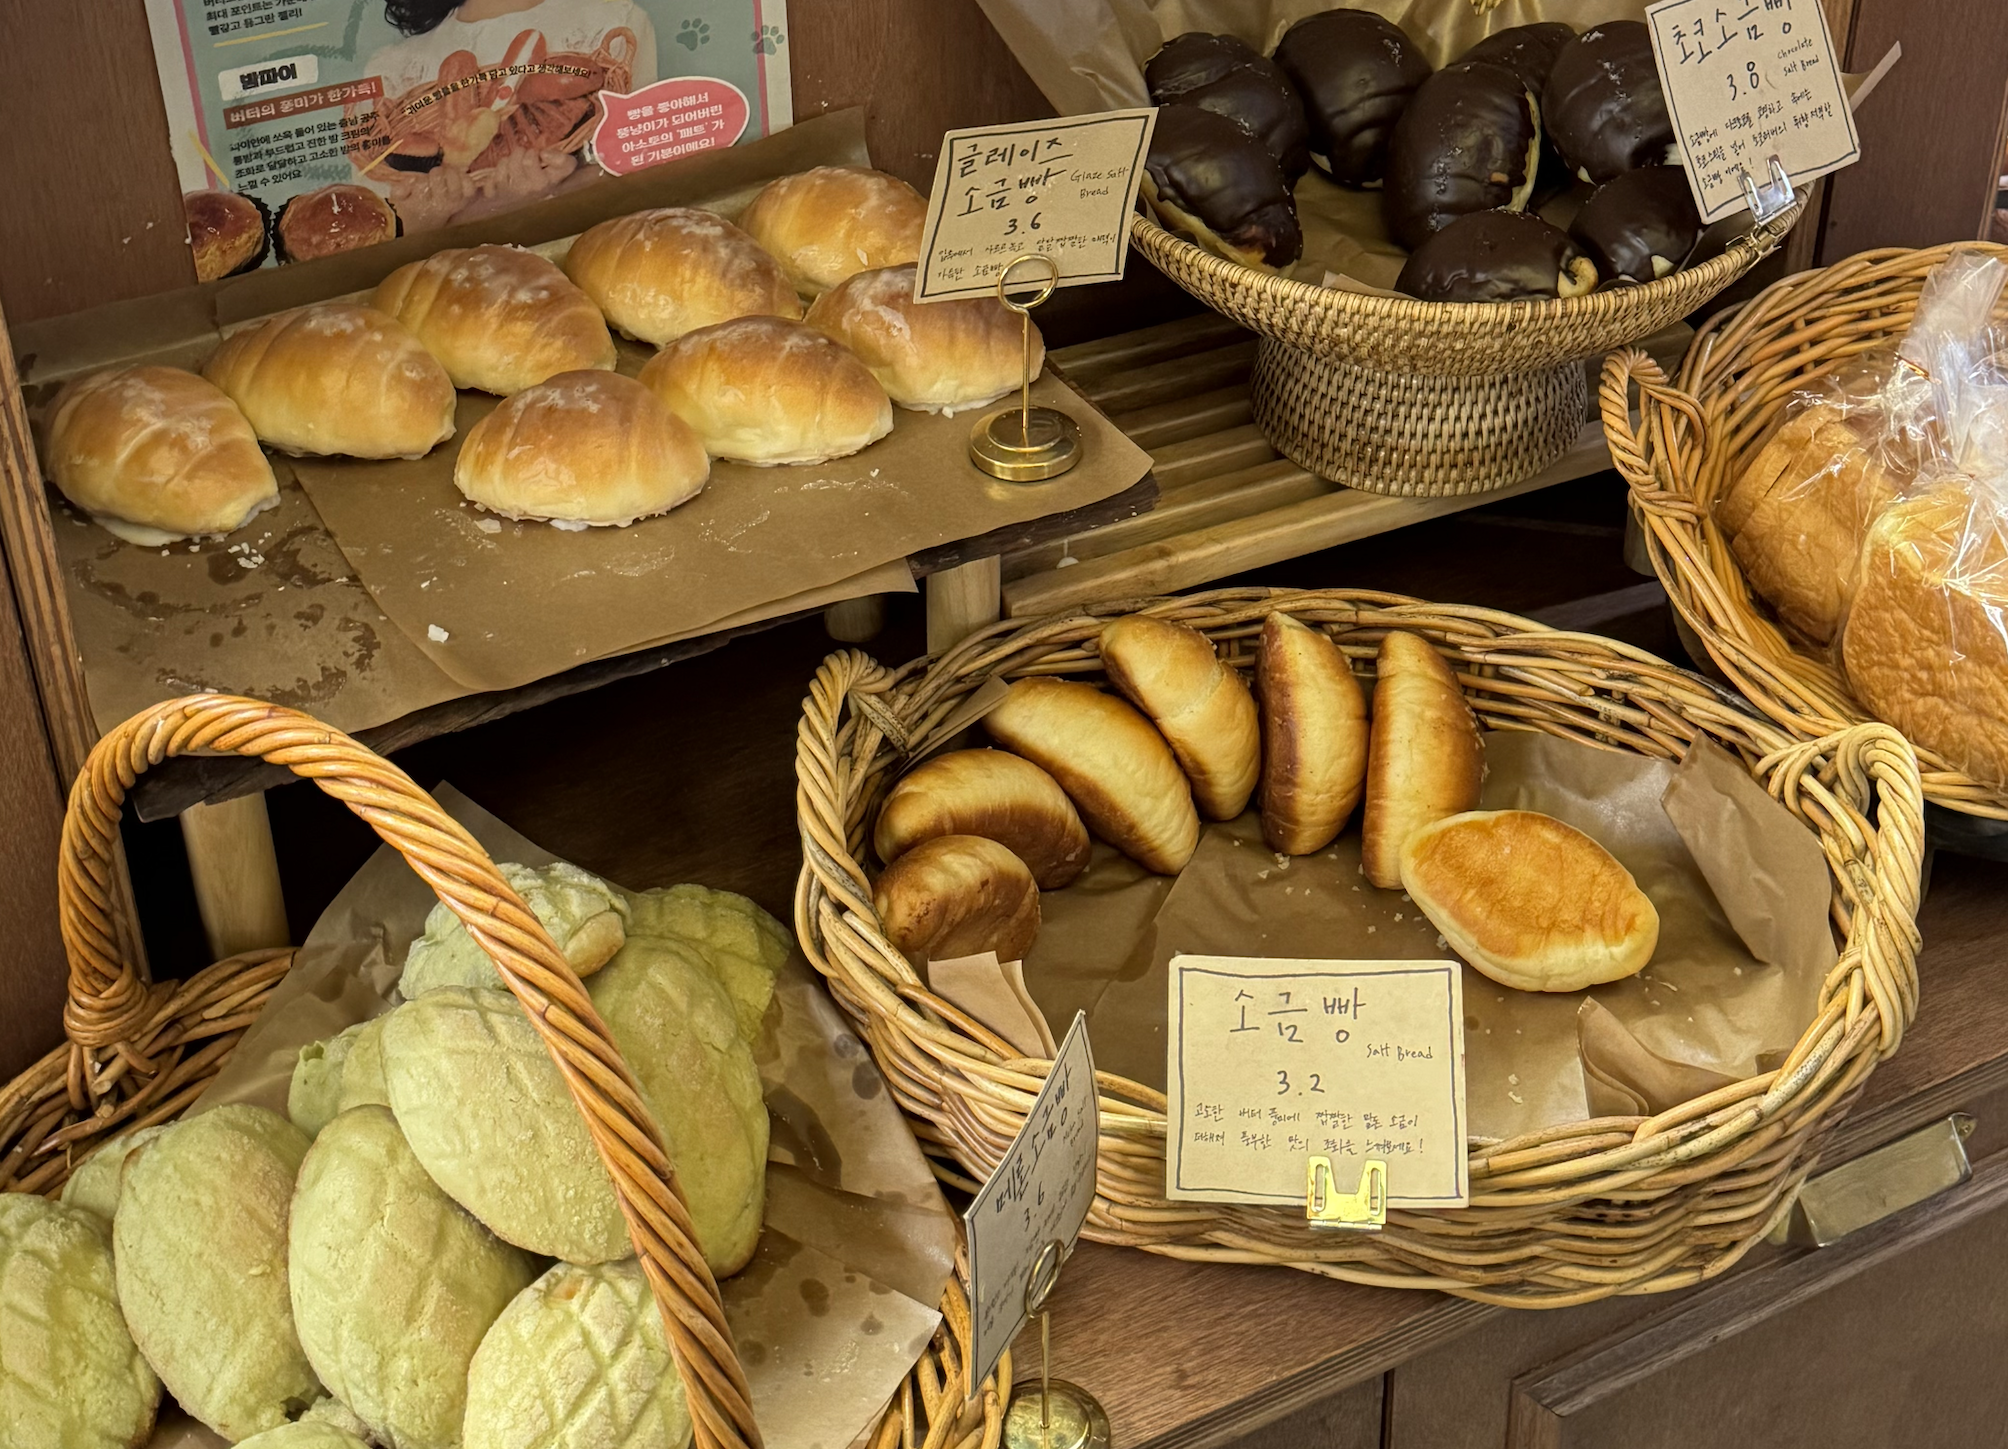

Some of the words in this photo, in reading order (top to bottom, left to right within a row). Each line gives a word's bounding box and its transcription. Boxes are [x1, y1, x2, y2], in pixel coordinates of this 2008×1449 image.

[231, 2, 272, 17] 포인트는
[239, 63, 298, 90] 밤파이
[461, 69, 488, 88] 한가득
[490, 67, 508, 81] 담고
[508, 64, 535, 77] 있다고
[1726, 61, 1760, 101] 3.8
[230, 103, 276, 123] 버터의
[280, 94, 324, 114] 풍미가
[327, 82, 376, 103] 한가득!
[627, 106, 655, 121] 빵을
[657, 92, 709, 115] 좋아해서
[671, 103, 722, 126] 되어버린
[295, 124, 315, 139] 들어
[317, 119, 337, 134] 있는
[711, 118, 725, 132] 가
[1689, 126, 1718, 148] 소금빵에
[264, 143, 304, 161] 부드럽고
[307, 139, 327, 154] 진한
[328, 134, 339, 147] 밤
[341, 126, 369, 144] 크림의
[647, 137, 715, 163] 기분이에요!
[235, 163, 265, 179] 조화로
[266, 154, 307, 174] 달달하고
[309, 147, 338, 162] 고소한
[340, 142, 360, 155] 밤의
[957, 137, 1073, 178] 글레이즈
[237, 177, 257, 192] 느낄
[259, 175, 270, 187] 수
[271, 169, 302, 184] 있어요
[956, 168, 1067, 217] 소금빵
[1080, 187, 1109, 199] Bread
[1003, 212, 1042, 236] 3.6
[972, 262, 1003, 278] 소금빵
[1229, 986, 1367, 1044] 소금빵
[1396, 1045, 1434, 1061] Bread
[1276, 1069, 1326, 1097] 3.2
[1238, 1107, 1262, 1121] 버터
[1268, 1106, 1301, 1127] 풍미에
[1389, 1114, 1419, 1129] 소금이
[1240, 1129, 1272, 1150] 풍부한
[1288, 1134, 1309, 1153] 맛의
[1022, 1180, 1045, 1233] 3.6
